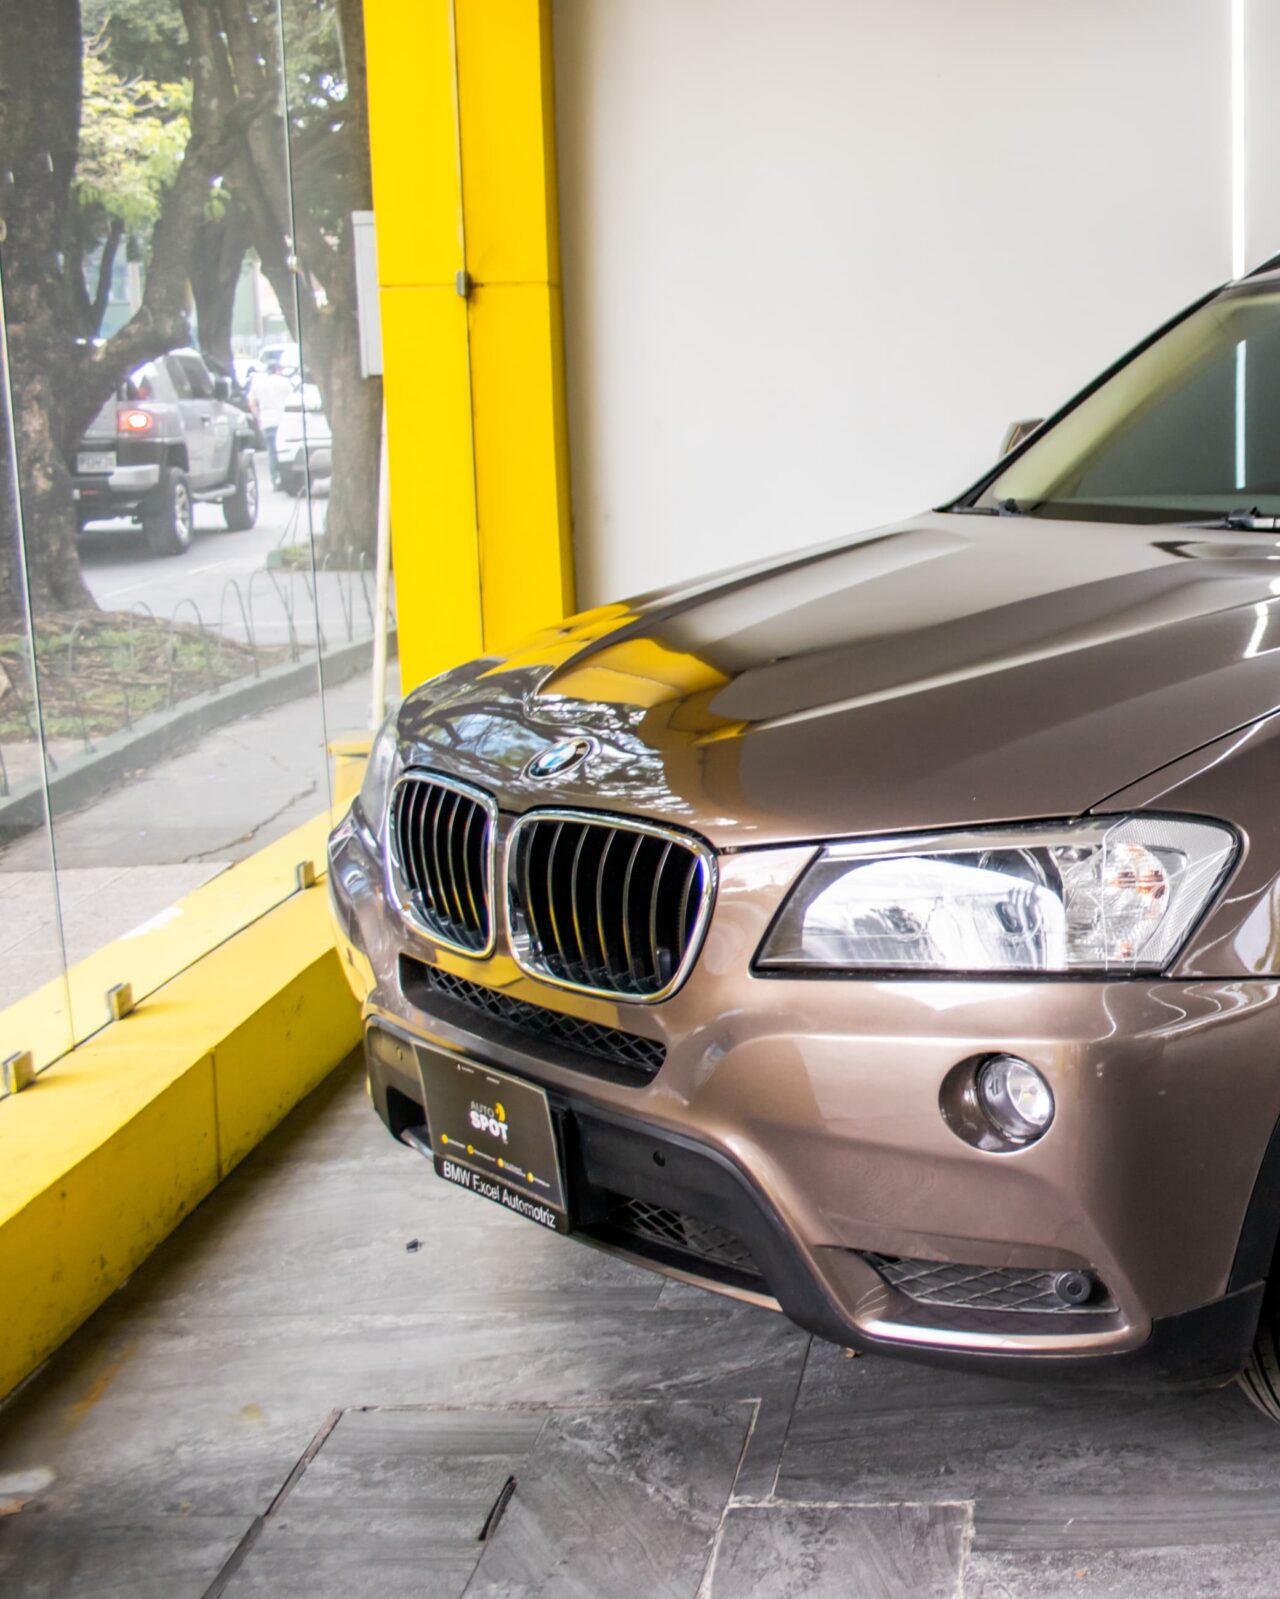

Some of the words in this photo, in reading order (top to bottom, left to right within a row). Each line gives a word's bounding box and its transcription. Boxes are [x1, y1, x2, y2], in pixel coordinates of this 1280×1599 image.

[470, 1110, 508, 1141] SPOT
[443, 1160, 471, 1187] BMW
[472, 1174, 500, 1201] Excel
[502, 1188, 557, 1229] Automotriz
